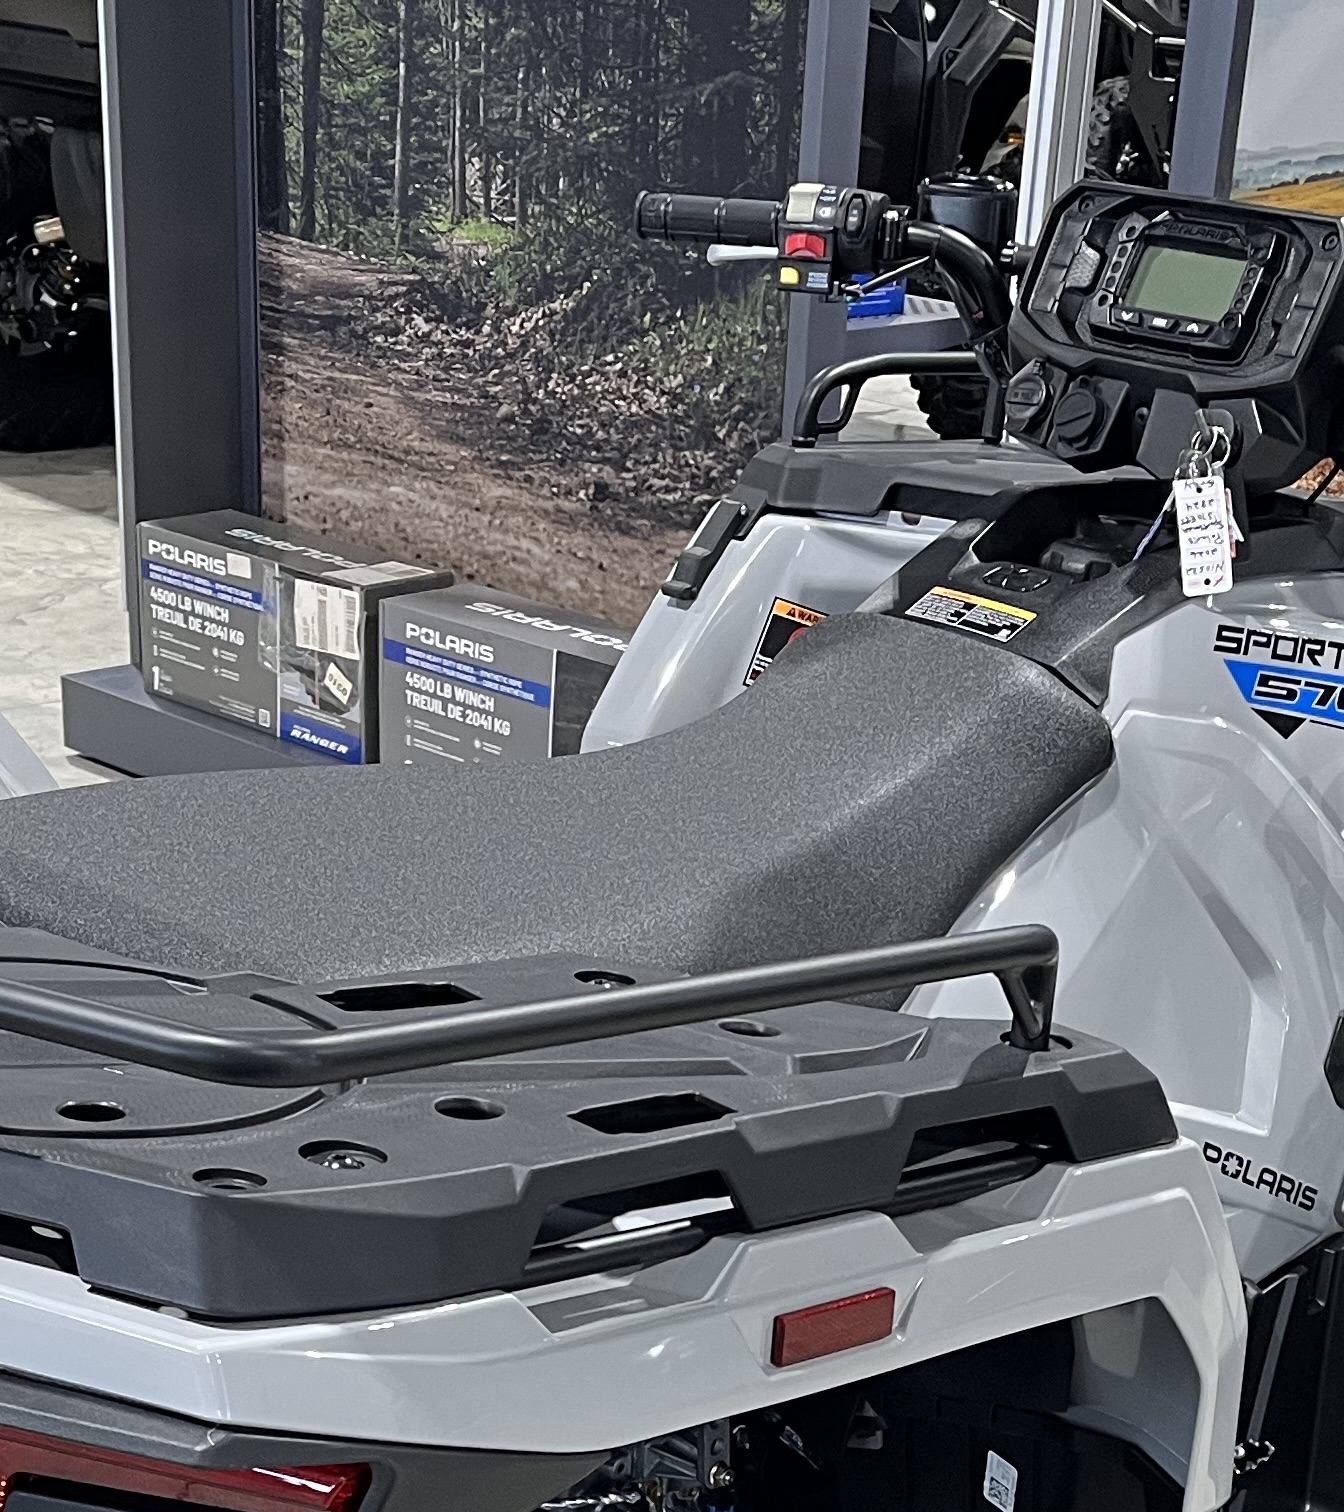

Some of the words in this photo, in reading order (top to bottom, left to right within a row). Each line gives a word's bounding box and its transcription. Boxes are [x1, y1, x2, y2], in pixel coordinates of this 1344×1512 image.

[148, 539, 226, 576] POLARIS
[150, 586, 176, 607] 4500
[178, 594, 192, 612] LB
[193, 599, 229, 623] WINCH
[150, 603, 187, 628] TREUIL
[188, 615, 203, 634] DE
[204, 621, 228, 641] 2041
[229, 628, 245, 646] KG
[406, 622, 494, 663] POLARIS
[405, 671, 435, 693] 4500
[436, 682, 452, 699] LB
[454, 686, 495, 712] WINCH
[405, 689, 446, 717] TREUIL
[447, 703, 464, 722] DE
[465, 709, 492, 731] 2041
[494, 717, 511, 736] KG
[290, 728, 349, 754] RANGER
[1202, 1141, 1319, 1211] POLARIS
